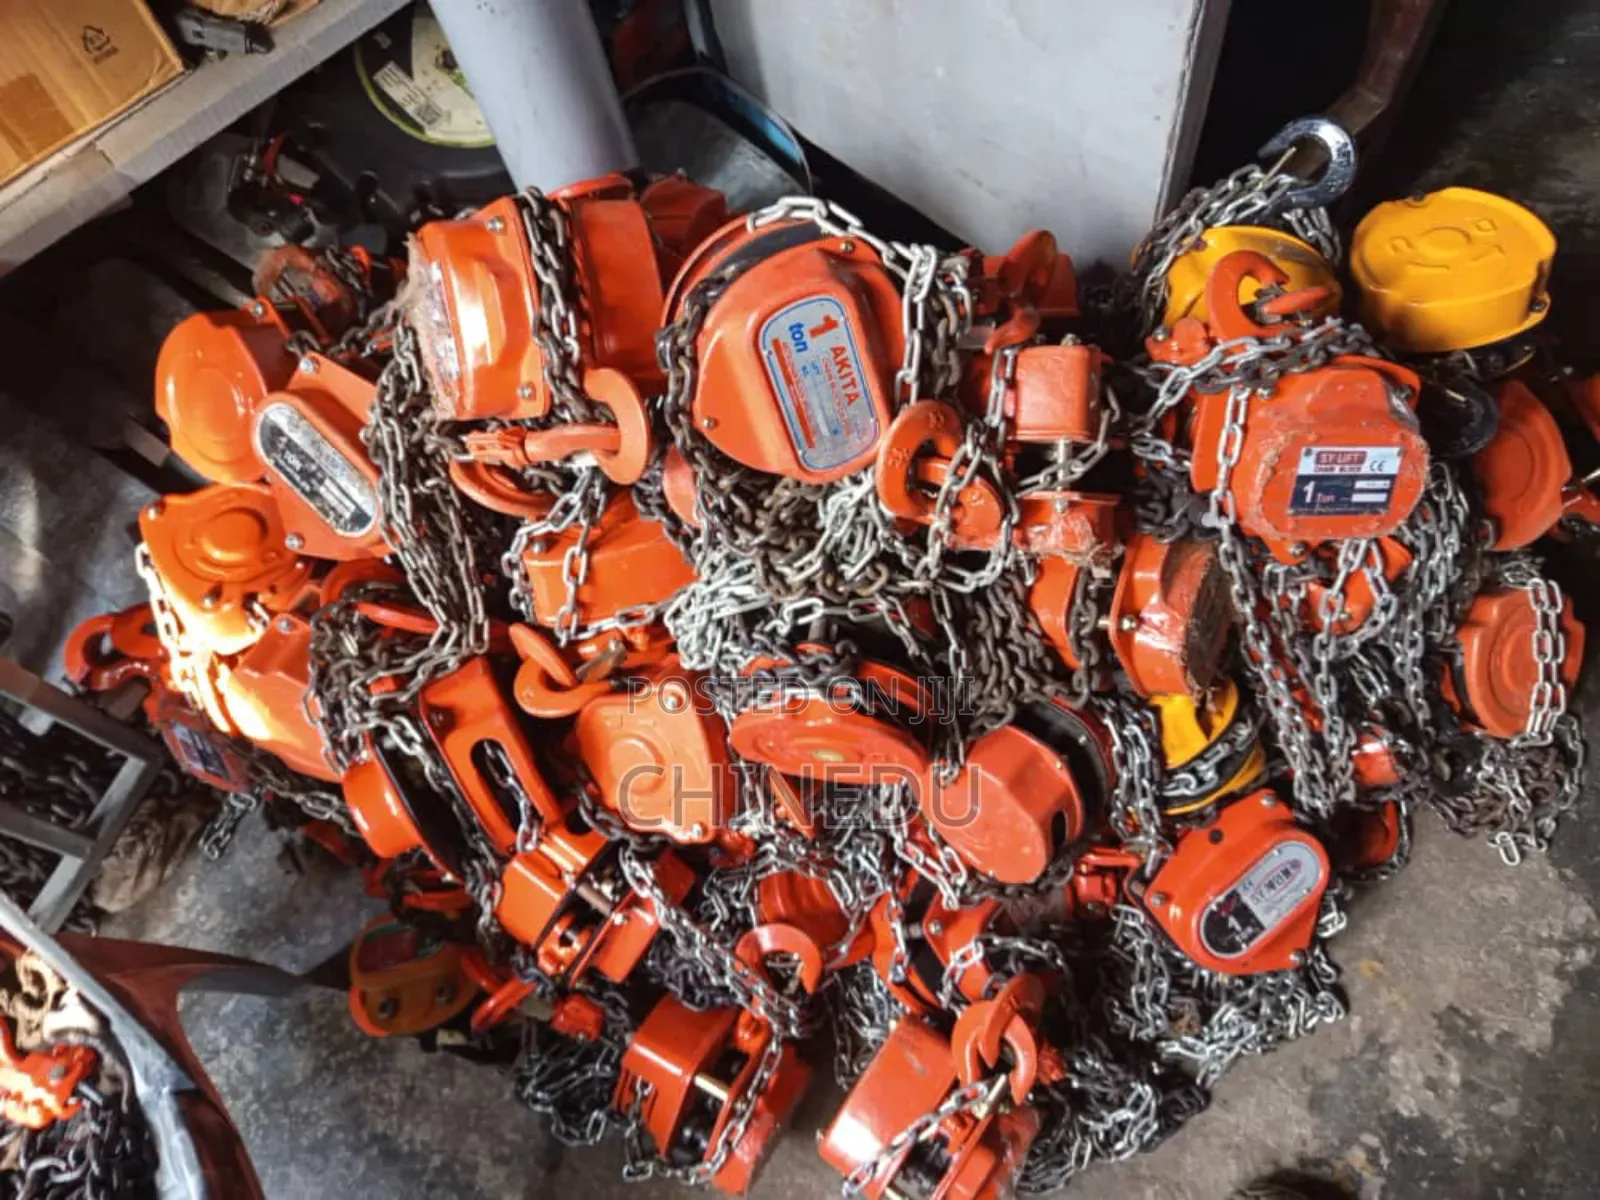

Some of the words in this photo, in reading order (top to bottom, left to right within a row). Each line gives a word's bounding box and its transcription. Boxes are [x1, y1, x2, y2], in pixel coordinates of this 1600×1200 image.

[789, 322, 808, 352] ton
[810, 314, 838, 338] 1
[831, 346, 861, 405] AKITA
[1303, 480, 1316, 504] 1
[1227, 915, 1243, 933] 1
